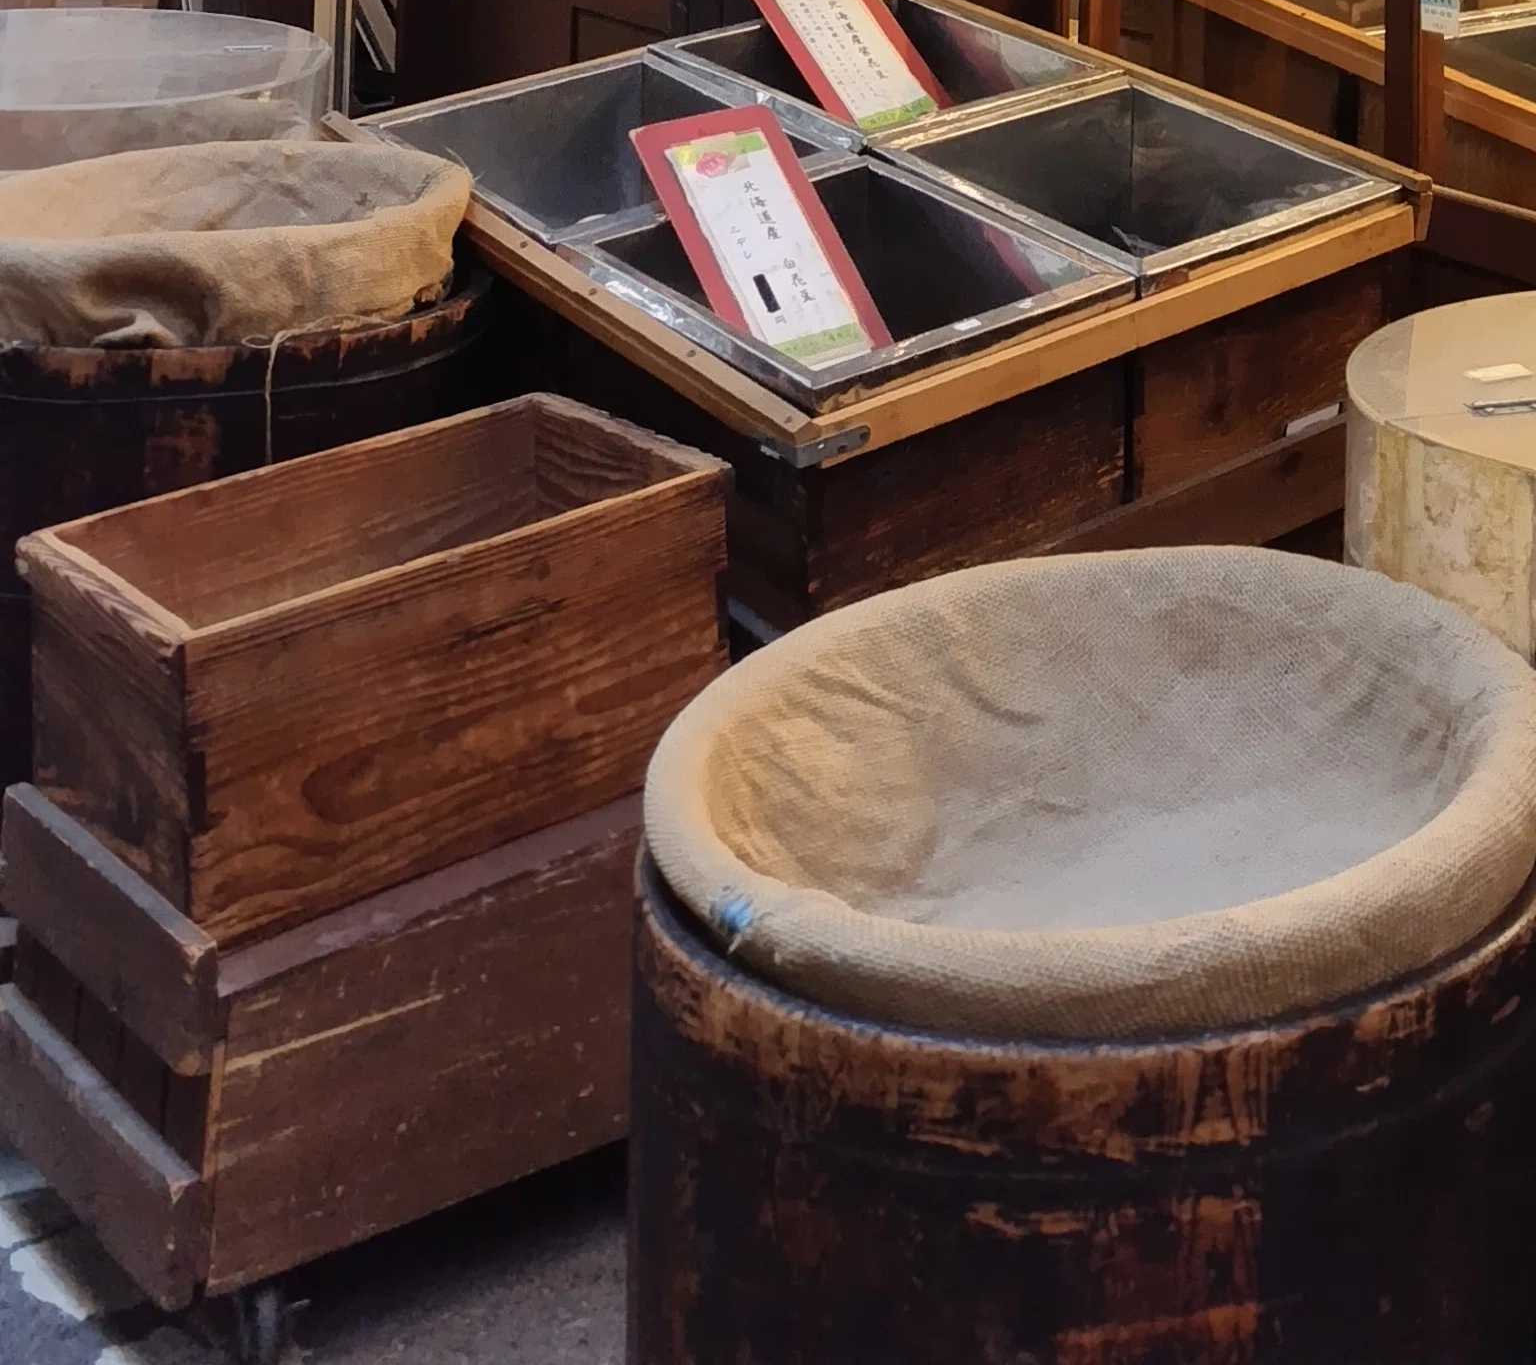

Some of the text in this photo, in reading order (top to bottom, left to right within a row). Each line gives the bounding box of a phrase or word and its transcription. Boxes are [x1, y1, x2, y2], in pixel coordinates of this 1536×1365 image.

[742, 180, 816, 304] 北海道産 白花豆
